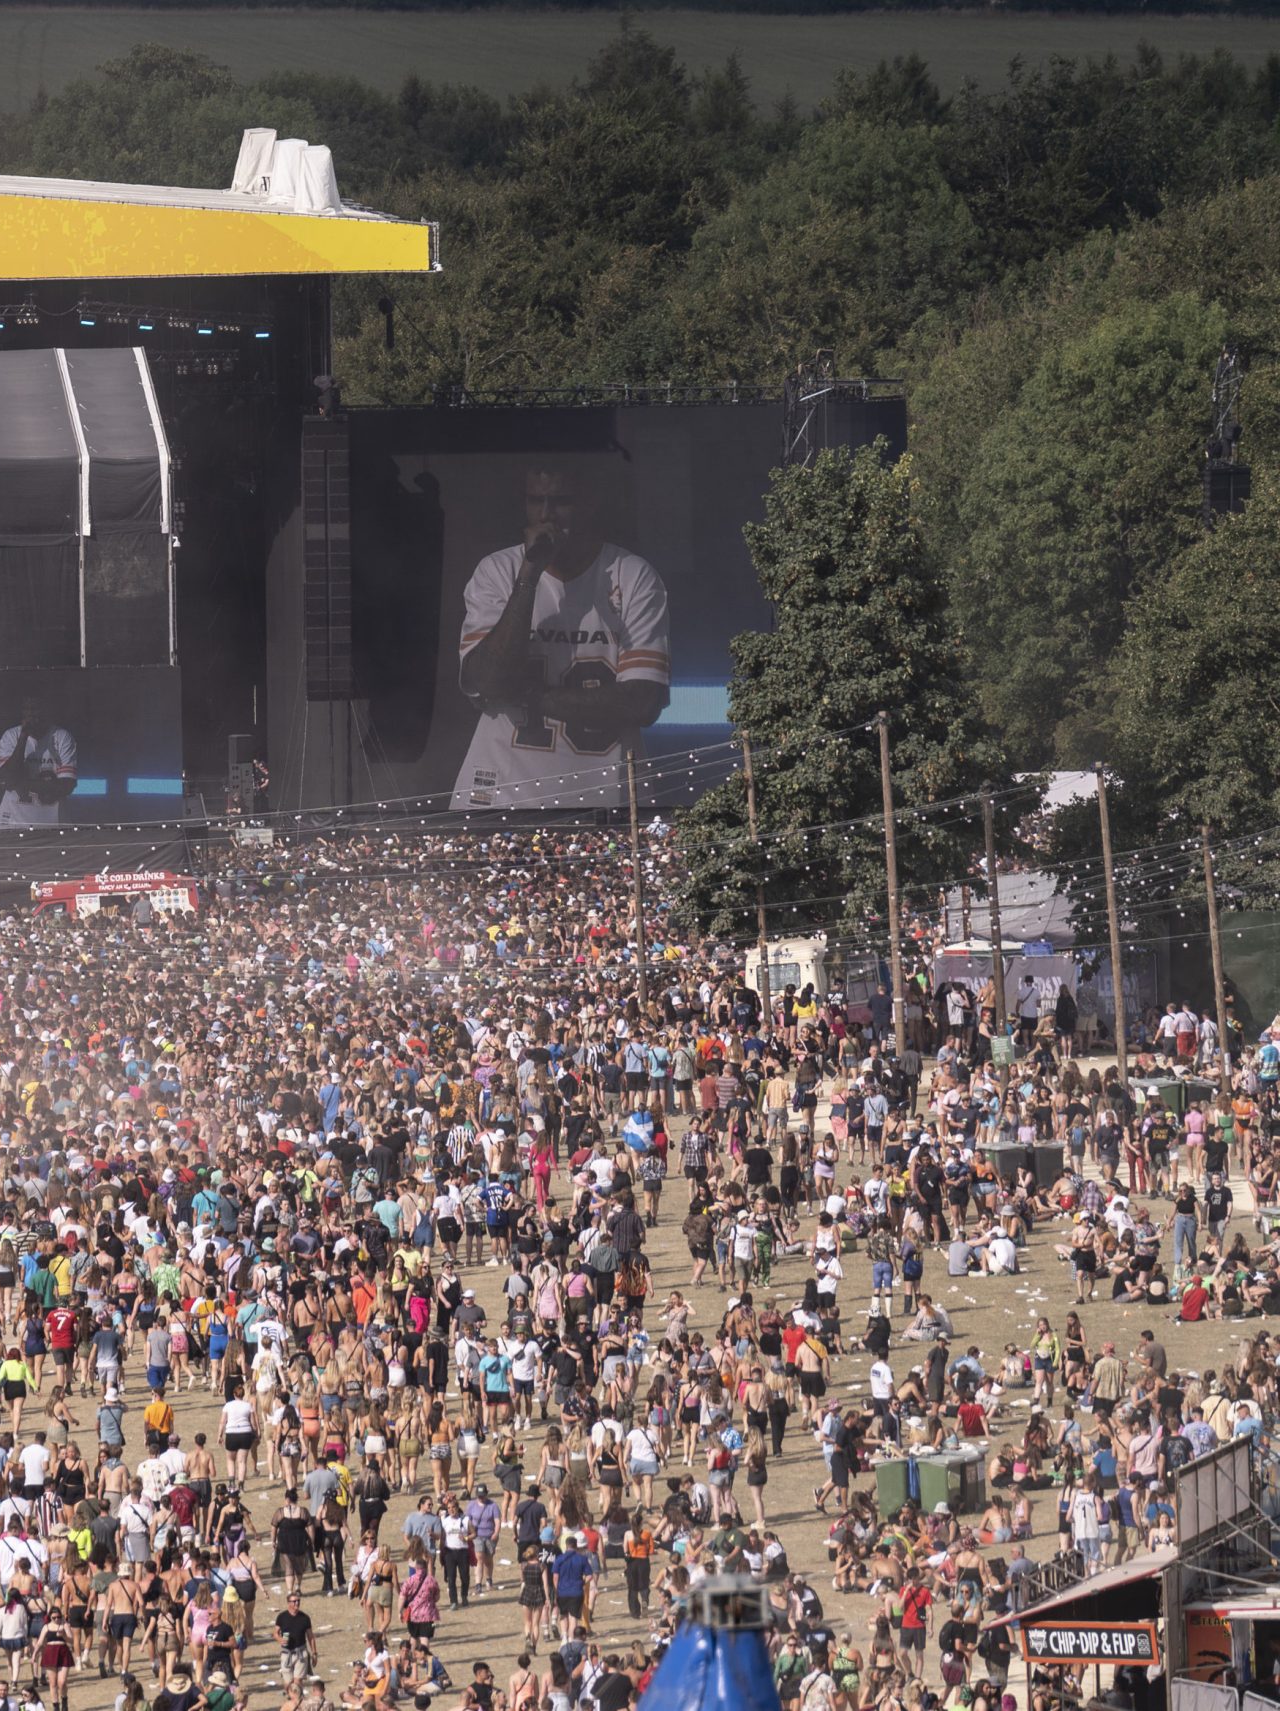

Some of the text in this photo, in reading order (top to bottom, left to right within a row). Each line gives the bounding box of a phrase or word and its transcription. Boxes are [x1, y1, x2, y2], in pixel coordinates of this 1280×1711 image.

[110, 873, 131, 882] COLD
[133, 872, 165, 881] DRINKS
[56, 1316, 67, 1330] 7
[1101, 1632, 1112, 1655] &
[1112, 1633, 1135, 1655] FLIP
